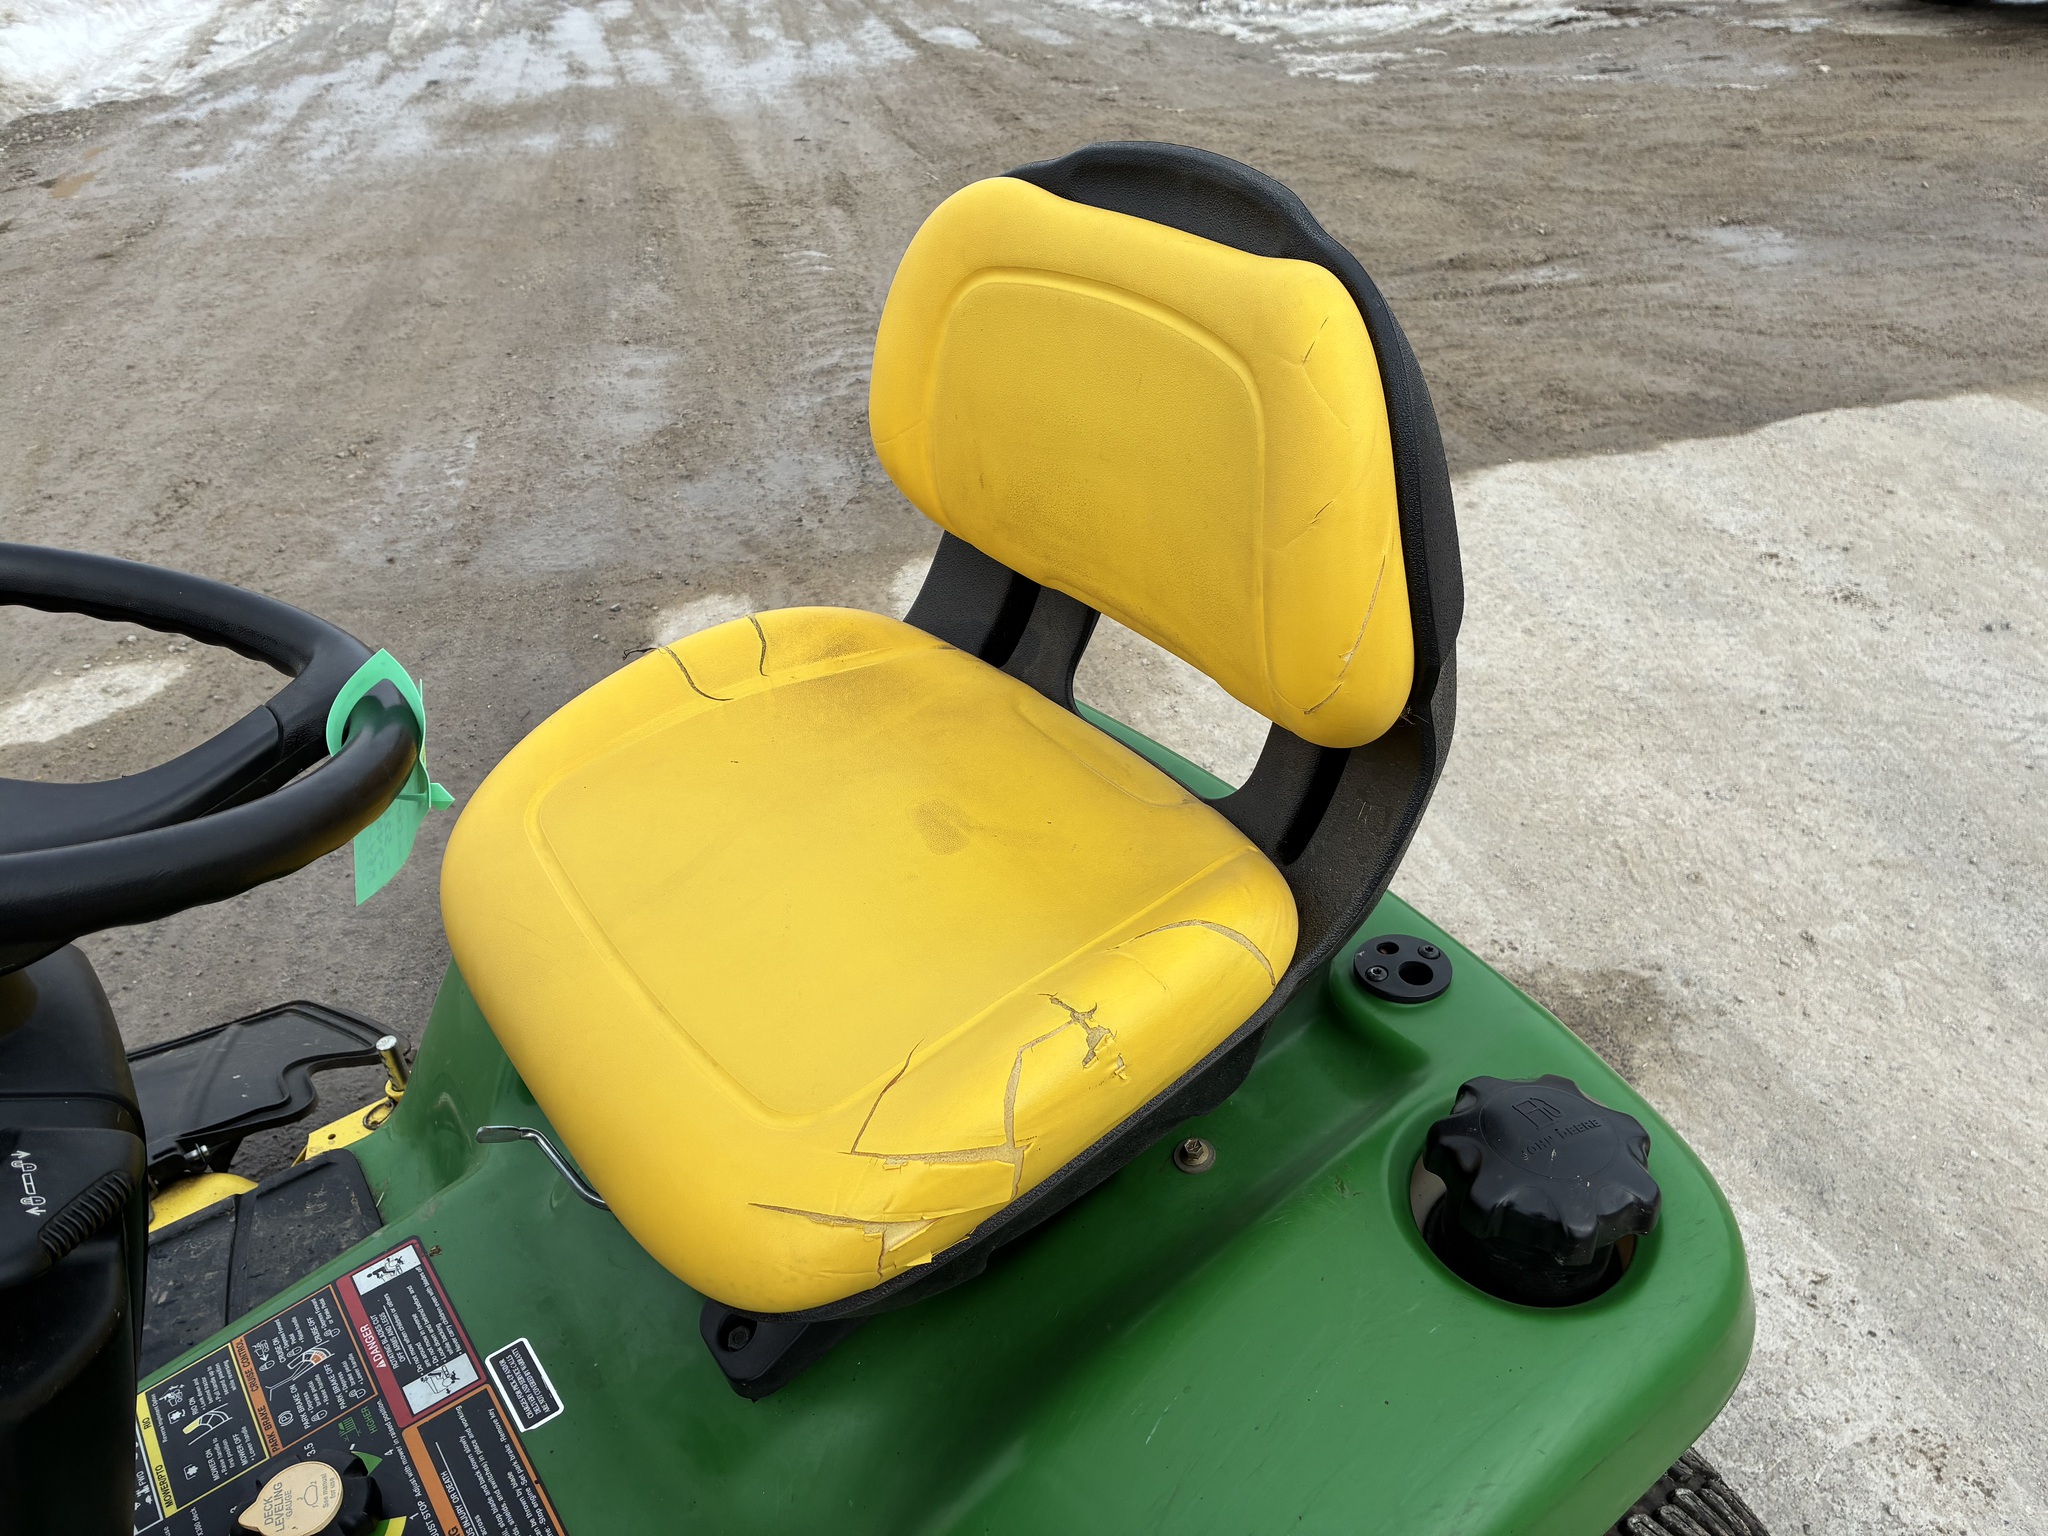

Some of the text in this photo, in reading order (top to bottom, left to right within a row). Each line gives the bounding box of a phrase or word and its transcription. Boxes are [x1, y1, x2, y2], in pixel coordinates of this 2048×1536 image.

[1555, 1119, 1602, 1139] DEERE
[419, 1272, 430, 1287] blades
[384, 1293, 393, 1307] others
[426, 1286, 434, 1297] with
[431, 1295, 440, 1307] even
[319, 1298, 327, 1309] Pedal
[311, 1298, 327, 1329] Depress Forward
[393, 1313, 404, 1331] children
[406, 1285, 446, 1360] Look down and behind before and
[412, 1313, 423, 1330] reverse
[437, 1306, 449, 1325] children
[291, 1316, 300, 1331] handle
[306, 1317, 322, 1344] CRUISE OFF
[445, 1325, 455, 1337] carry
[274, 1319, 289, 1349] Depress Forward
[288, 1333, 297, 1345] Pedal
[359, 1323, 383, 1361] DANGER
[370, 1314, 399, 1369] ROTATING BLADES CUT
[379, 1312, 406, 1362] OFF ARMS AND LEGS
[401, 1331, 410, 1344] when
[422, 1335, 431, 1347] mow
[435, 1323, 454, 1355] while backing
[272, 1337, 286, 1363] CRUISE ON
[407, 1344, 416, 1356] mow
[415, 1342, 427, 1359] around
[427, 1346, 435, 1356] not
[451, 1337, 462, 1352] Never
[223, 1359, 233, 1379] reversing
[236, 1339, 259, 1392] CRUISE CONTROL
[348, 1353, 363, 1382] Lower handle
[412, 1355, 420, 1365] not
[416, 1364, 424, 1373] Do
[432, 1355, 439, 1364] Do
[192, 1377, 200, 1386] and
[215, 1363, 229, 1395] second position
[337, 1371, 348, 1391] Depress
[341, 1360, 356, 1386] brake pedal
[201, 1377, 213, 1404] behind tractor
[210, 1376, 218, 1391] handle
[315, 1374, 329, 1403] Raise handle
[323, 1364, 347, 1410] PARK BRAKE OFF
[303, 1391, 314, 1411] Depress
[307, 1380, 321, 1407] brake pedal
[188, 1396, 199, 1415] RIO ON
[289, 1384, 311, 1429] PARK BRAKE ON
[142, 1417, 151, 1430] RIO
[361, 1406, 377, 1434] HIGHER
[455, 1405, 469, 1428] working
[257, 1405, 280, 1453] PARK BRAKE
[385, 1422, 397, 1440] raised
[465, 1427, 474, 1439] and
[214, 1443, 223, 1459] handle
[222, 1439, 233, 1458] position
[232, 1434, 248, 1466] MOWER OFF
[241, 1426, 256, 1458] Lower handle
[304, 1442, 316, 1457] 3.5
[393, 1438, 400, 1446] in
[471, 1439, 483, 1455] place
[205, 1448, 220, 1481] MOWER ON
[396, 1446, 408, 1465] mower
[478, 1454, 485, 1463] in
[488, 1408, 538, 1508] engine park brake key
[219, 1459, 227, 1473] Raise
[404, 1465, 413, 1478] with
[481, 1461, 498, 1489] switches)
[136, 1471, 146, 1486] FWD
[155, 1465, 173, 1508] MOWER/PTO
[320, 1473, 328, 1495] manual
[409, 1477, 422, 1497] Adjust
[459, 1435, 505, 1528] stop blade and back down slowly
[284, 1490, 293, 1517] GAUGE
[440, 1471, 470, 1528] INJURY OR DEATH
[493, 1489, 503, 1501] and
[507, 1471, 537, 1528] be thrown by blade
[190, 1507, 199, 1521] deck
[263, 1496, 274, 1525] DECK
[273, 1482, 285, 1532] LEVELING
[409, 1512, 419, 1520] 1
[417, 1501, 431, 1520] STOP
[474, 1514, 487, 1536] across
